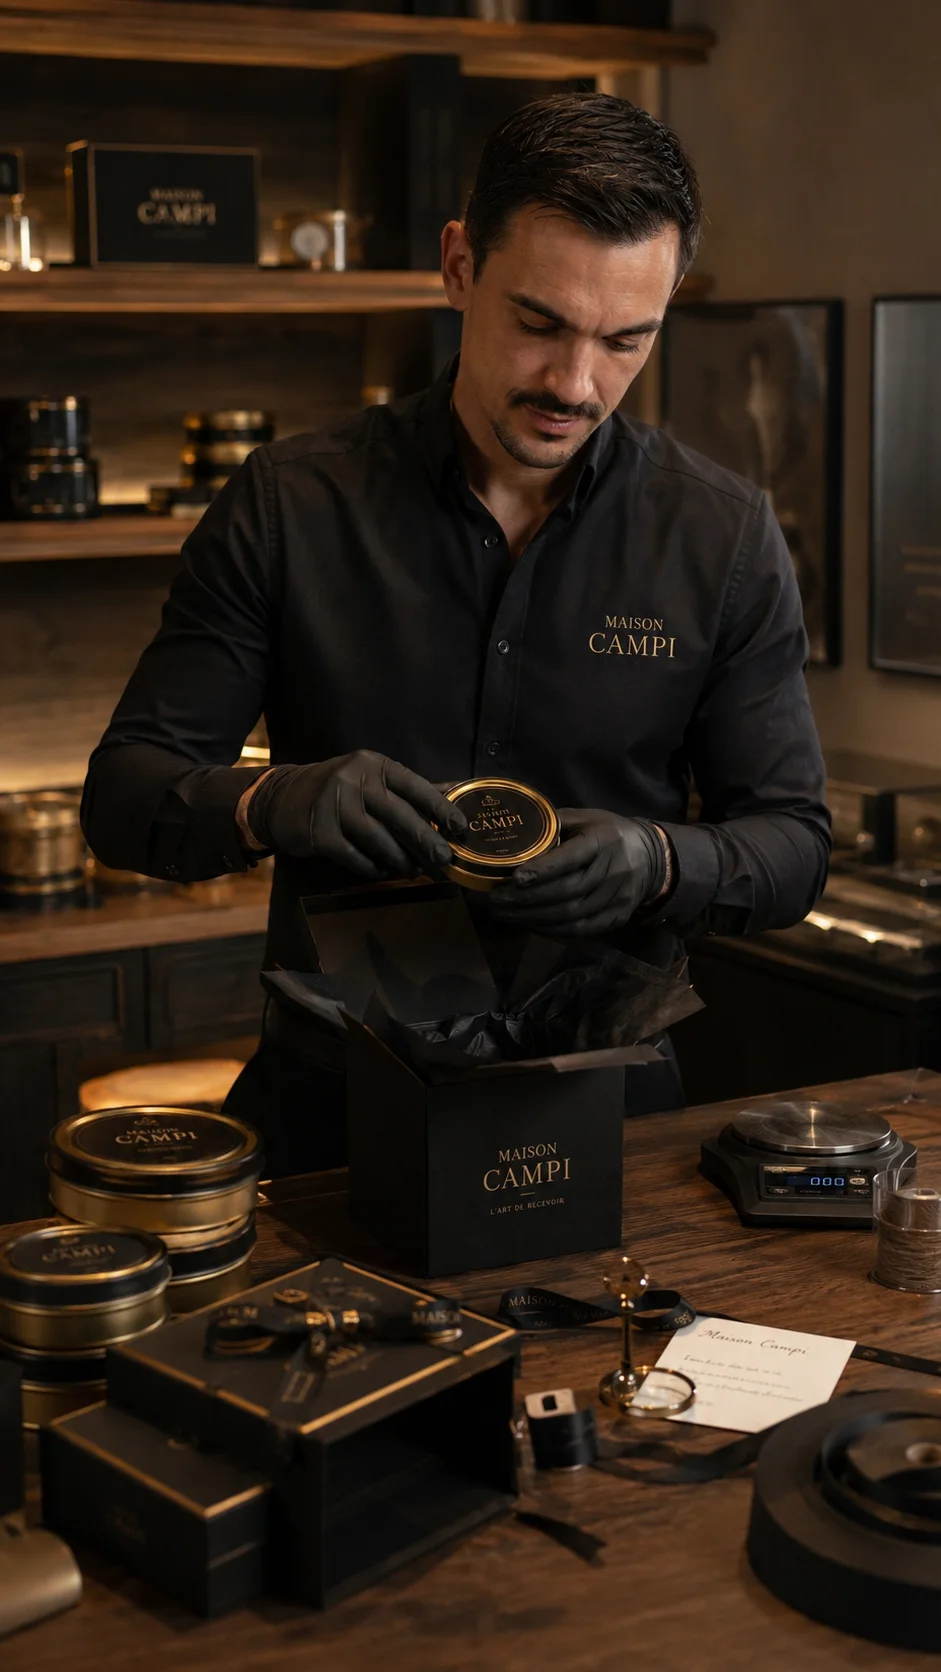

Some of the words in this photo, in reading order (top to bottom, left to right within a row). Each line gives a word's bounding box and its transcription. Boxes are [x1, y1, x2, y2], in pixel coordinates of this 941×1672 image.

[137, 202, 216, 225] CAMPI
[605, 615, 663, 631] MAISON
[589, 632, 676, 658] CAMPI
[469, 815, 524, 831] CAMPI
[115, 1131, 198, 1144] CAMPI
[499, 1142, 557, 1163] MAISON
[483, 1158, 571, 1191] CAMPI
[490, 1205, 512, 1215] L'ART
[515, 1203, 524, 1212] DE
[527, 1197, 565, 1209] RECEVOIR
[698, 1328, 753, 1346] Maison
[760, 1339, 811, 1356] Campi
